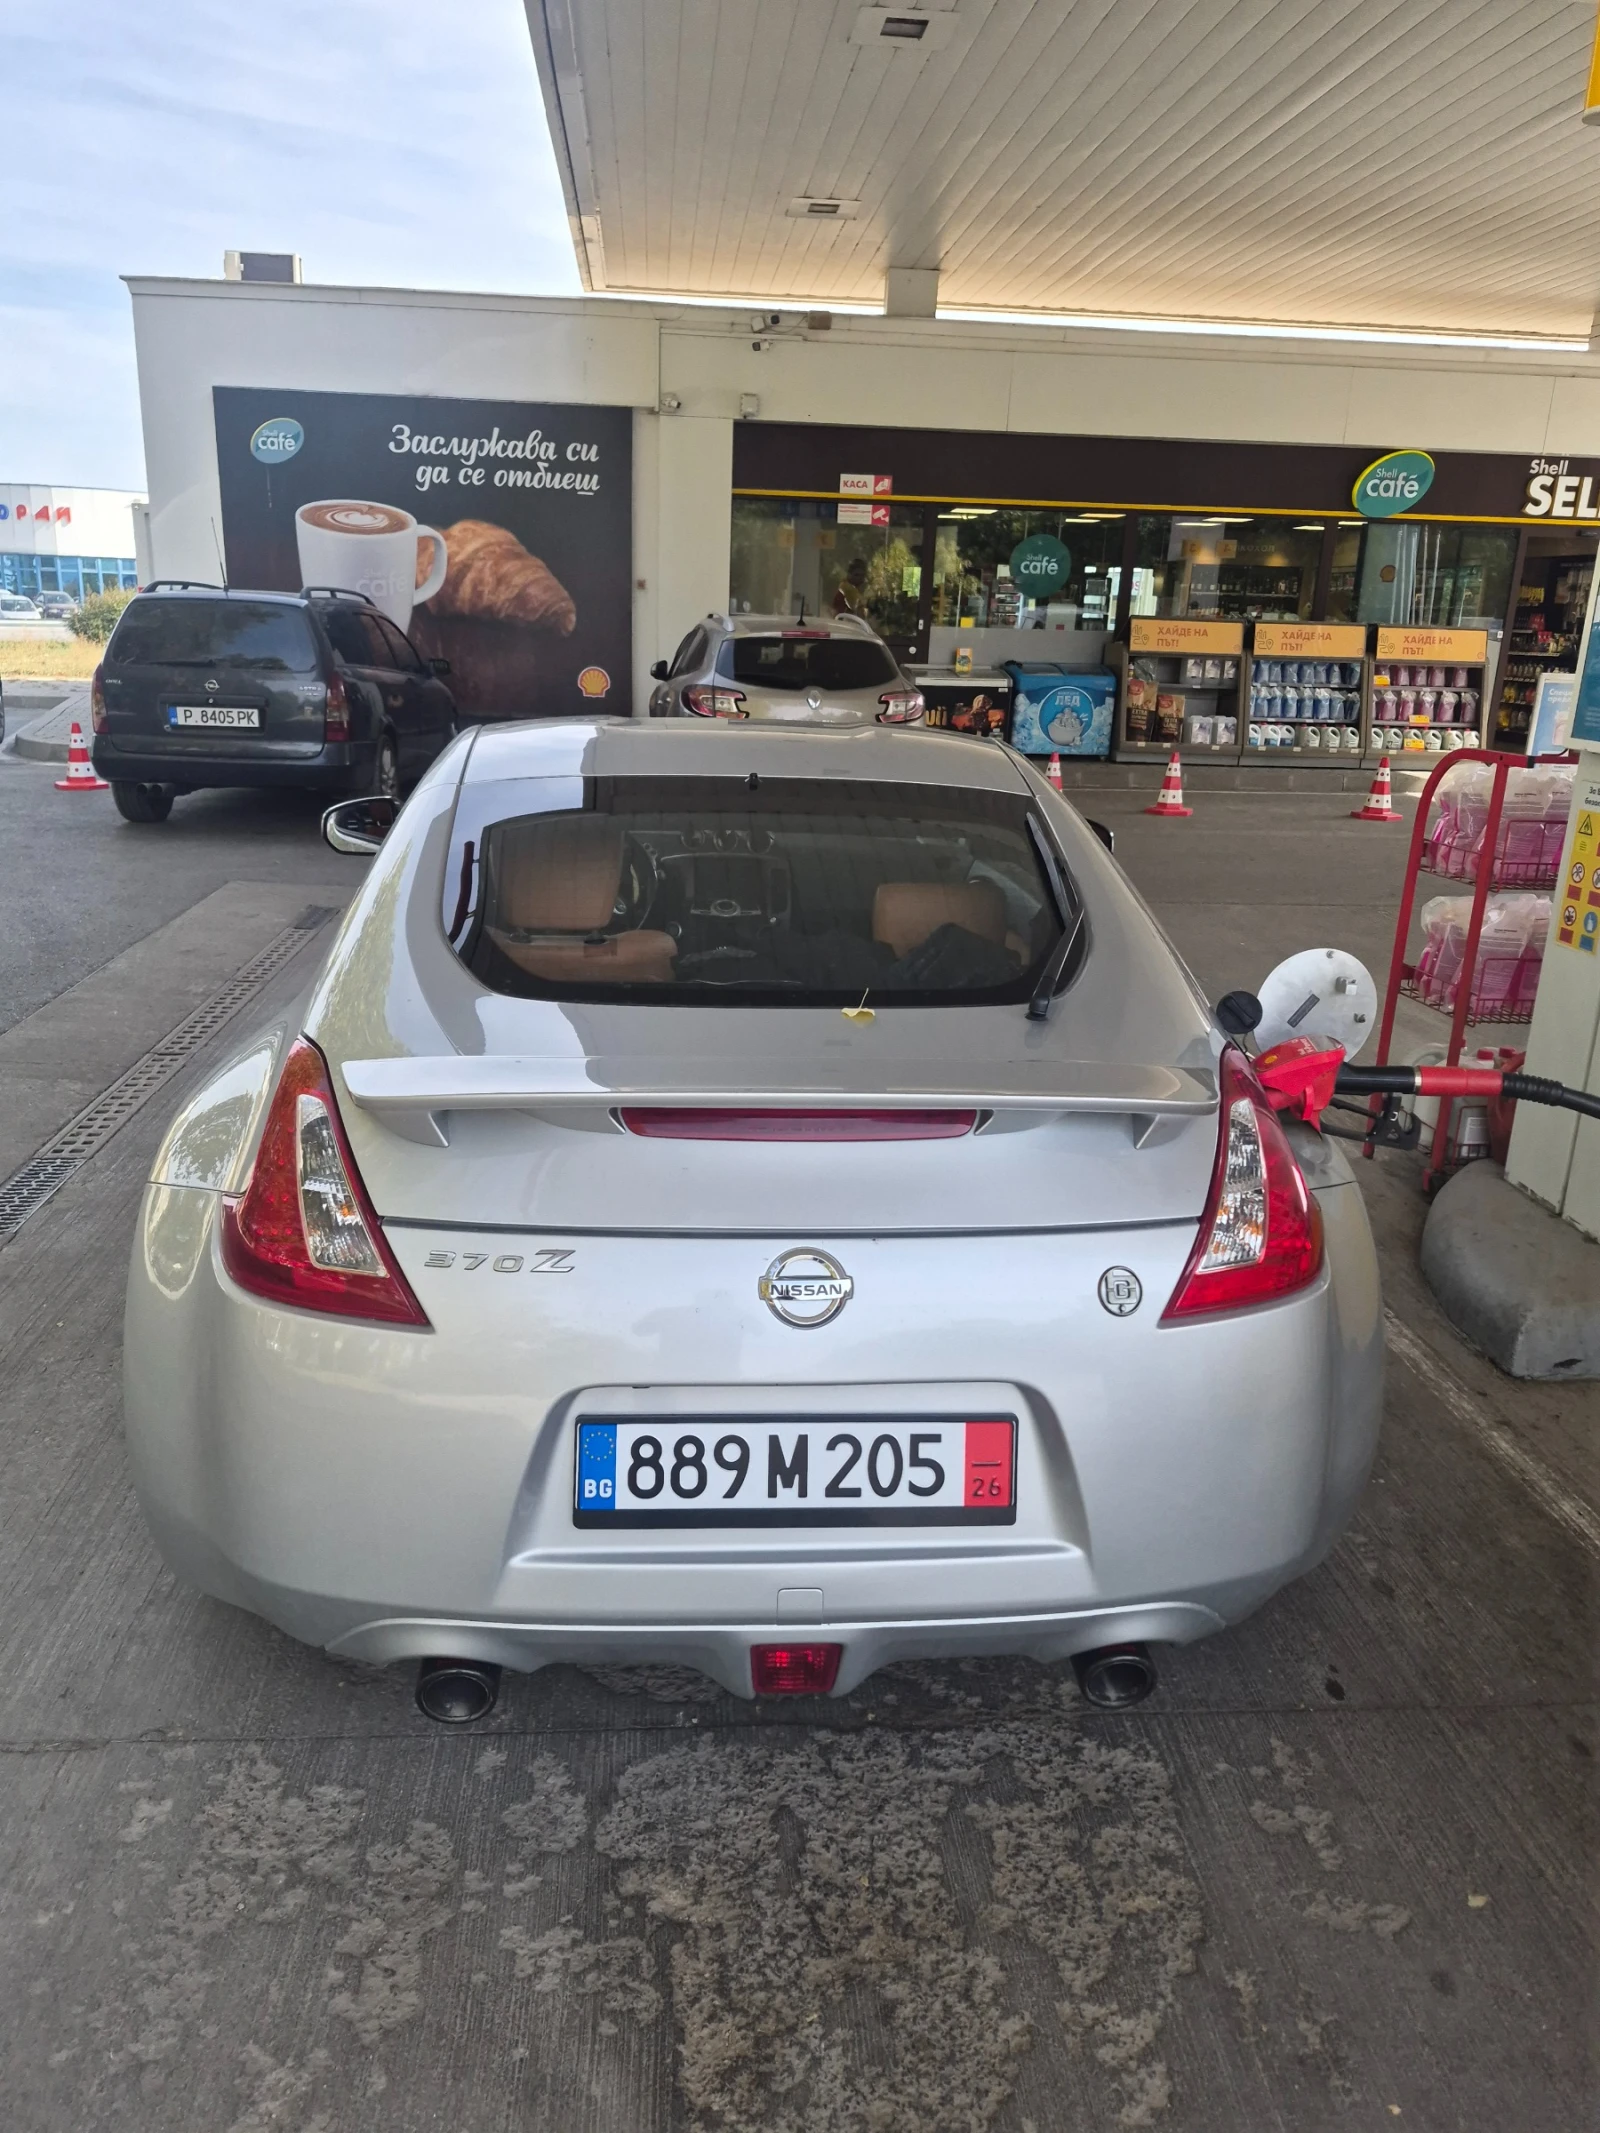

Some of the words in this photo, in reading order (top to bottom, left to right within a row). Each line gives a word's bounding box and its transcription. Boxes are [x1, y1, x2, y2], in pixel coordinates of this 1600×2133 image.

[258, 432, 296, 451] café
[388, 424, 558, 465] Заслужава
[566, 442, 599, 462] си
[1376, 468, 1398, 479] Shell
[1529, 459, 1569, 475] Shell
[415, 465, 450, 491] да
[458, 467, 485, 485] се
[493, 461, 600, 495] отбиеш
[843, 480, 868, 488] КАСА
[1366, 471, 1419, 498] café
[1523, 475, 1600, 518] SEL
[1020, 556, 1059, 575] café
[1158, 626, 1191, 637] ХАЙДЕ
[1194, 629, 1208, 637] НА
[1281, 629, 1315, 641] ХАЙДЕ
[1318, 632, 1332, 641] НА
[1403, 633, 1437, 645] ХАЙДЕ
[1439, 637, 1453, 645] НА
[1157, 639, 1179, 647] ПЪТ!
[1281, 643, 1303, 651] ПЪТ!
[1402, 647, 1424, 655] ПЪТ!
[1055, 695, 1080, 706] ЛЕД
[424, 1249, 576, 1273] 370Z
[770, 1283, 842, 1296] NISSAN
[627, 1434, 750, 1499] 889
[768, 1434, 808, 1498] M
[825, 1433, 945, 1498] 205
[584, 1479, 613, 1498] BG
[972, 1478, 1001, 1498] 26
